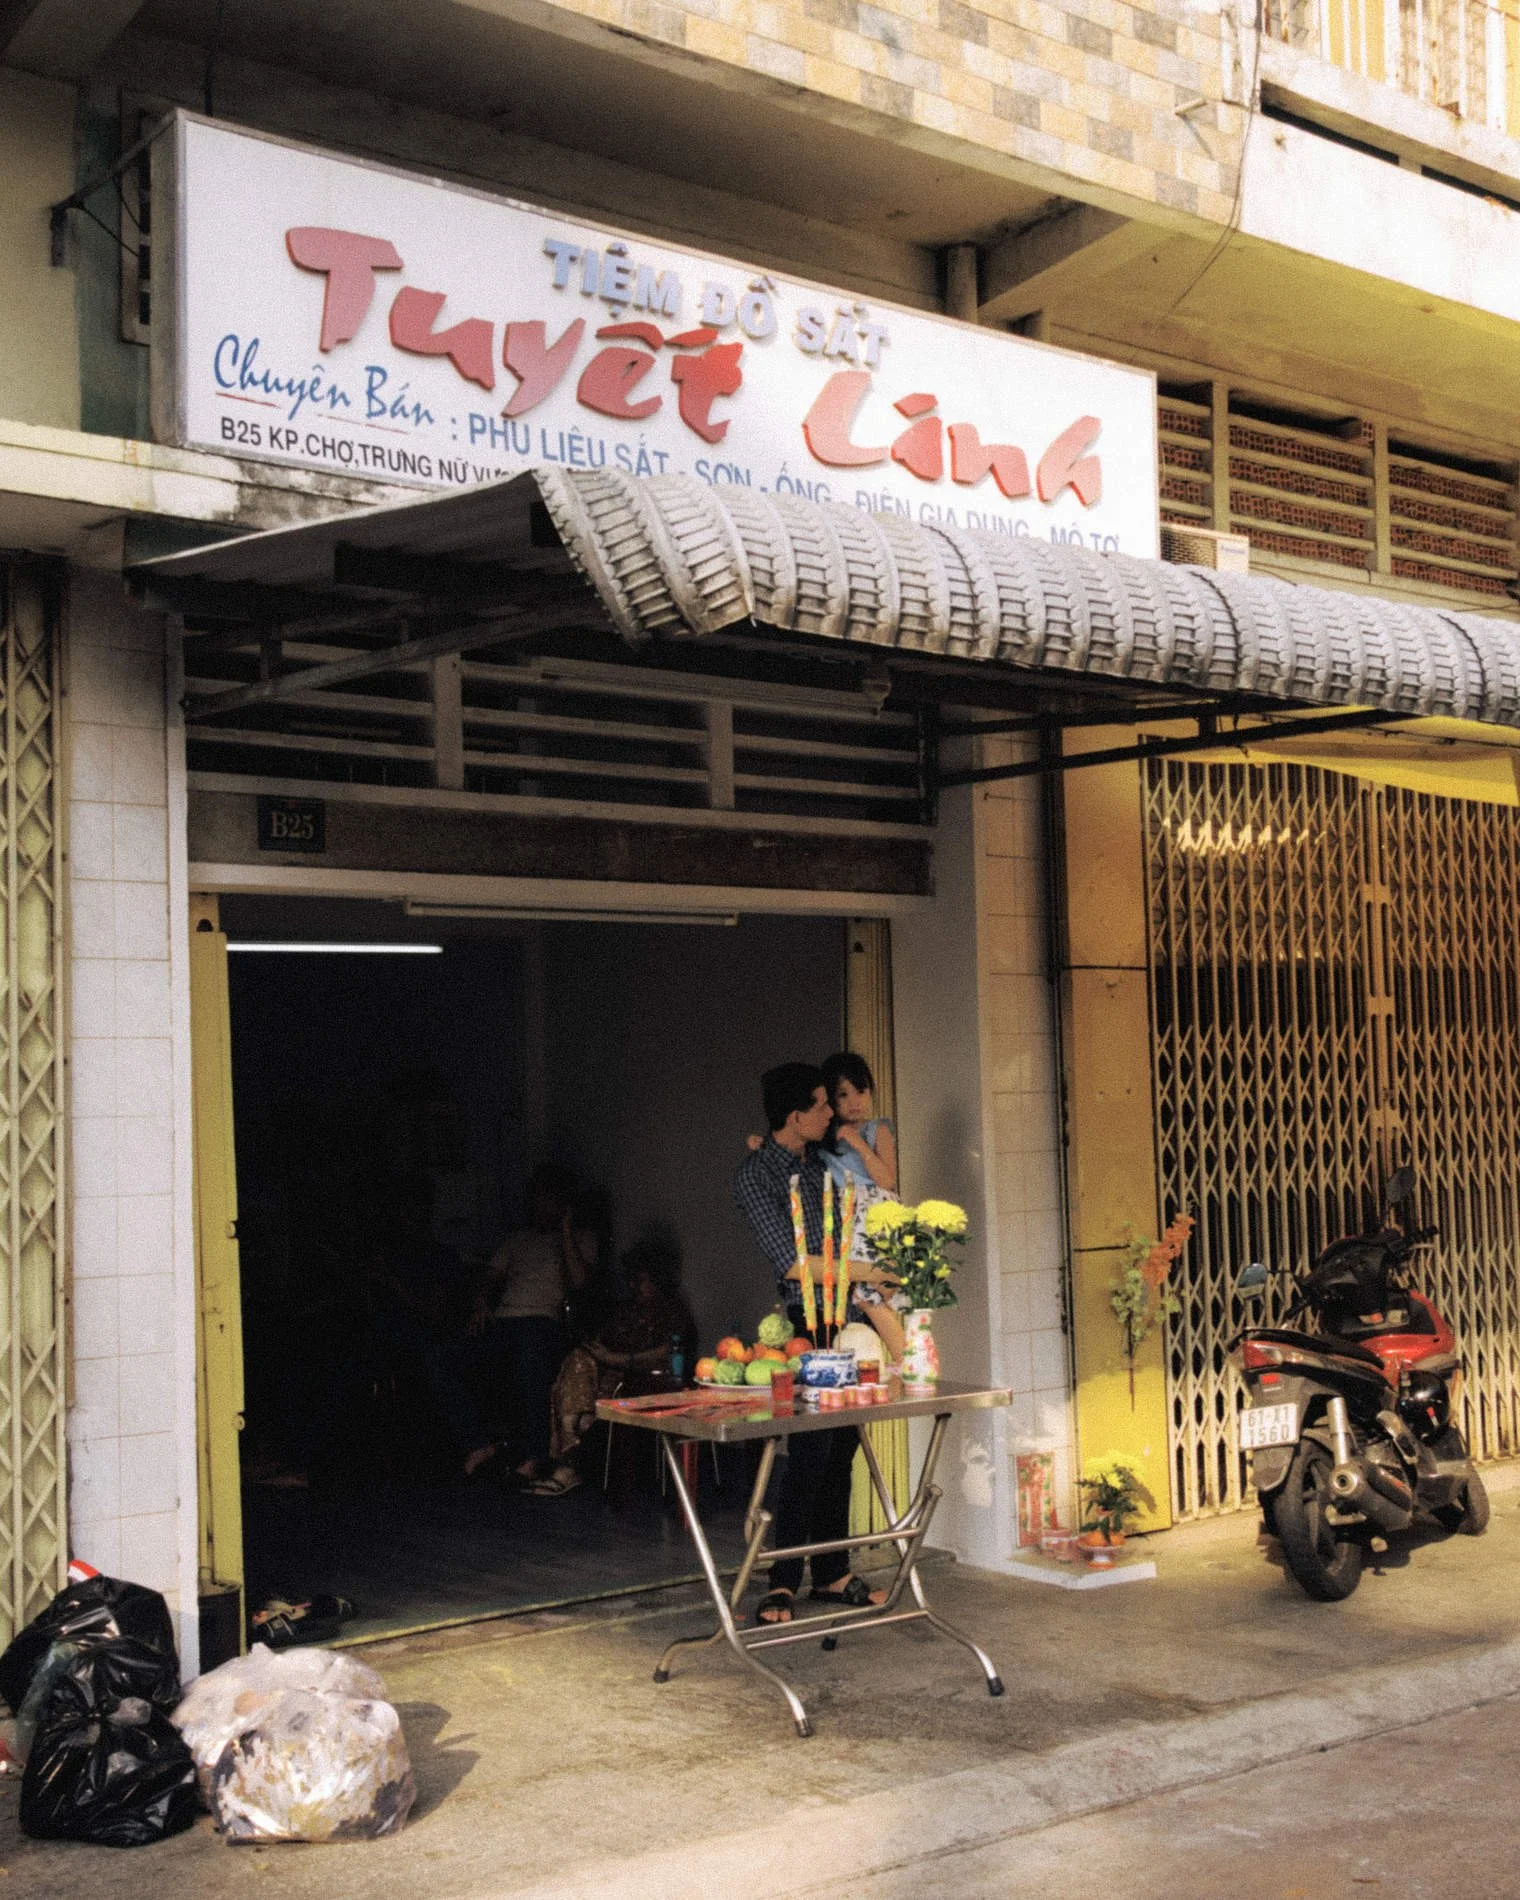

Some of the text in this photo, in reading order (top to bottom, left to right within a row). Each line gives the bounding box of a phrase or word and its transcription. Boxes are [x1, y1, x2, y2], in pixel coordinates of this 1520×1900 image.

[543, 238, 682, 318] TIỆM
[698, 275, 778, 338] ĐỒ
[214, 334, 351, 420] Chuyên
[365, 365, 434, 426] Bán
[285, 227, 1102, 508] Tuyết Linh
[220, 416, 262, 446] B25
[271, 811, 315, 839] B25
